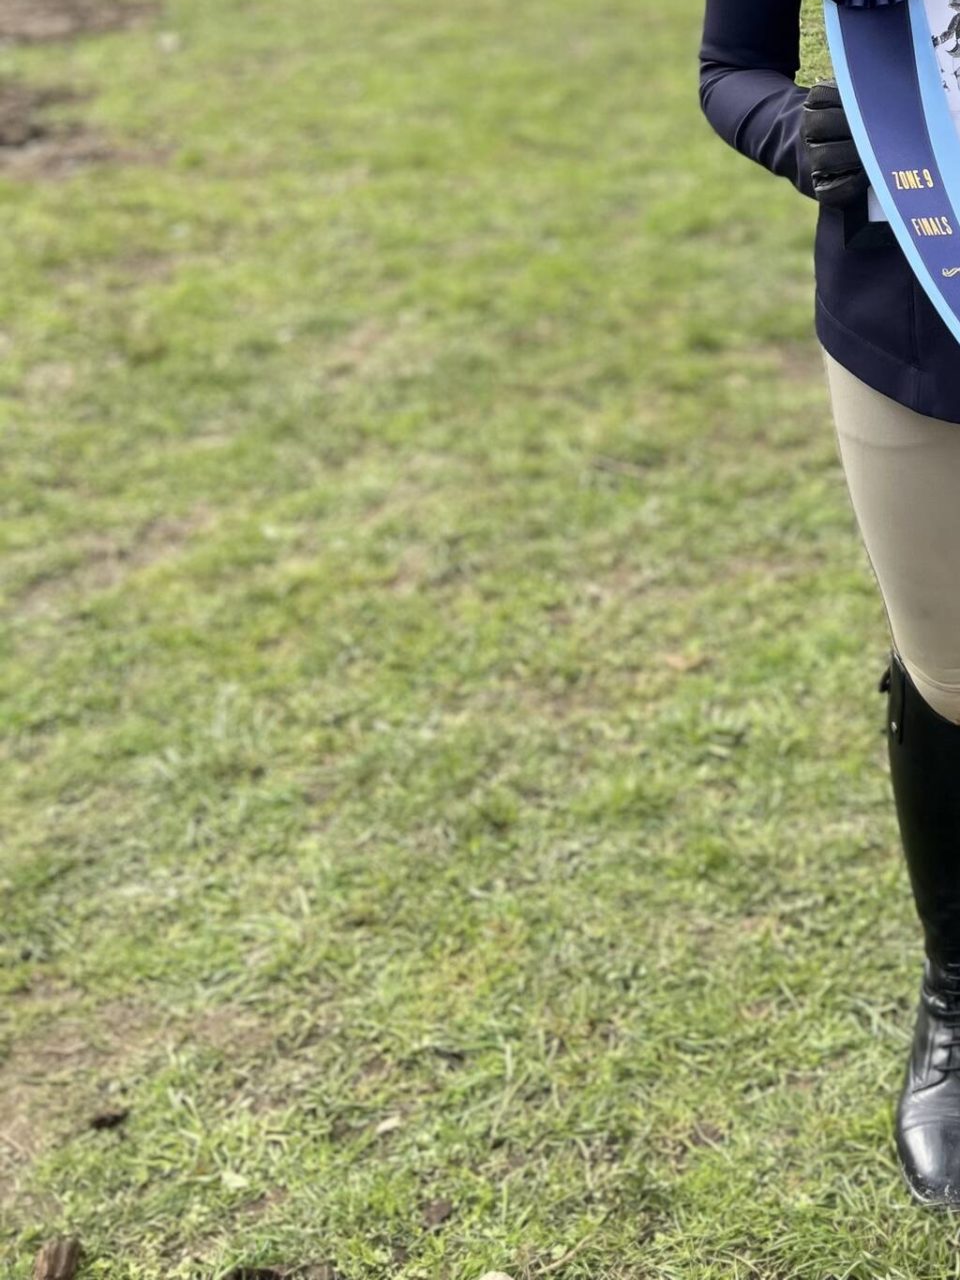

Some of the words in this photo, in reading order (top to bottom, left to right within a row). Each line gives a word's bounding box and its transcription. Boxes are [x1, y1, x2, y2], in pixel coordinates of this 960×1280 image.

[891, 169, 923, 190] ZONE
[924, 169, 934, 188] 9
[911, 216, 953, 236] FINALS
